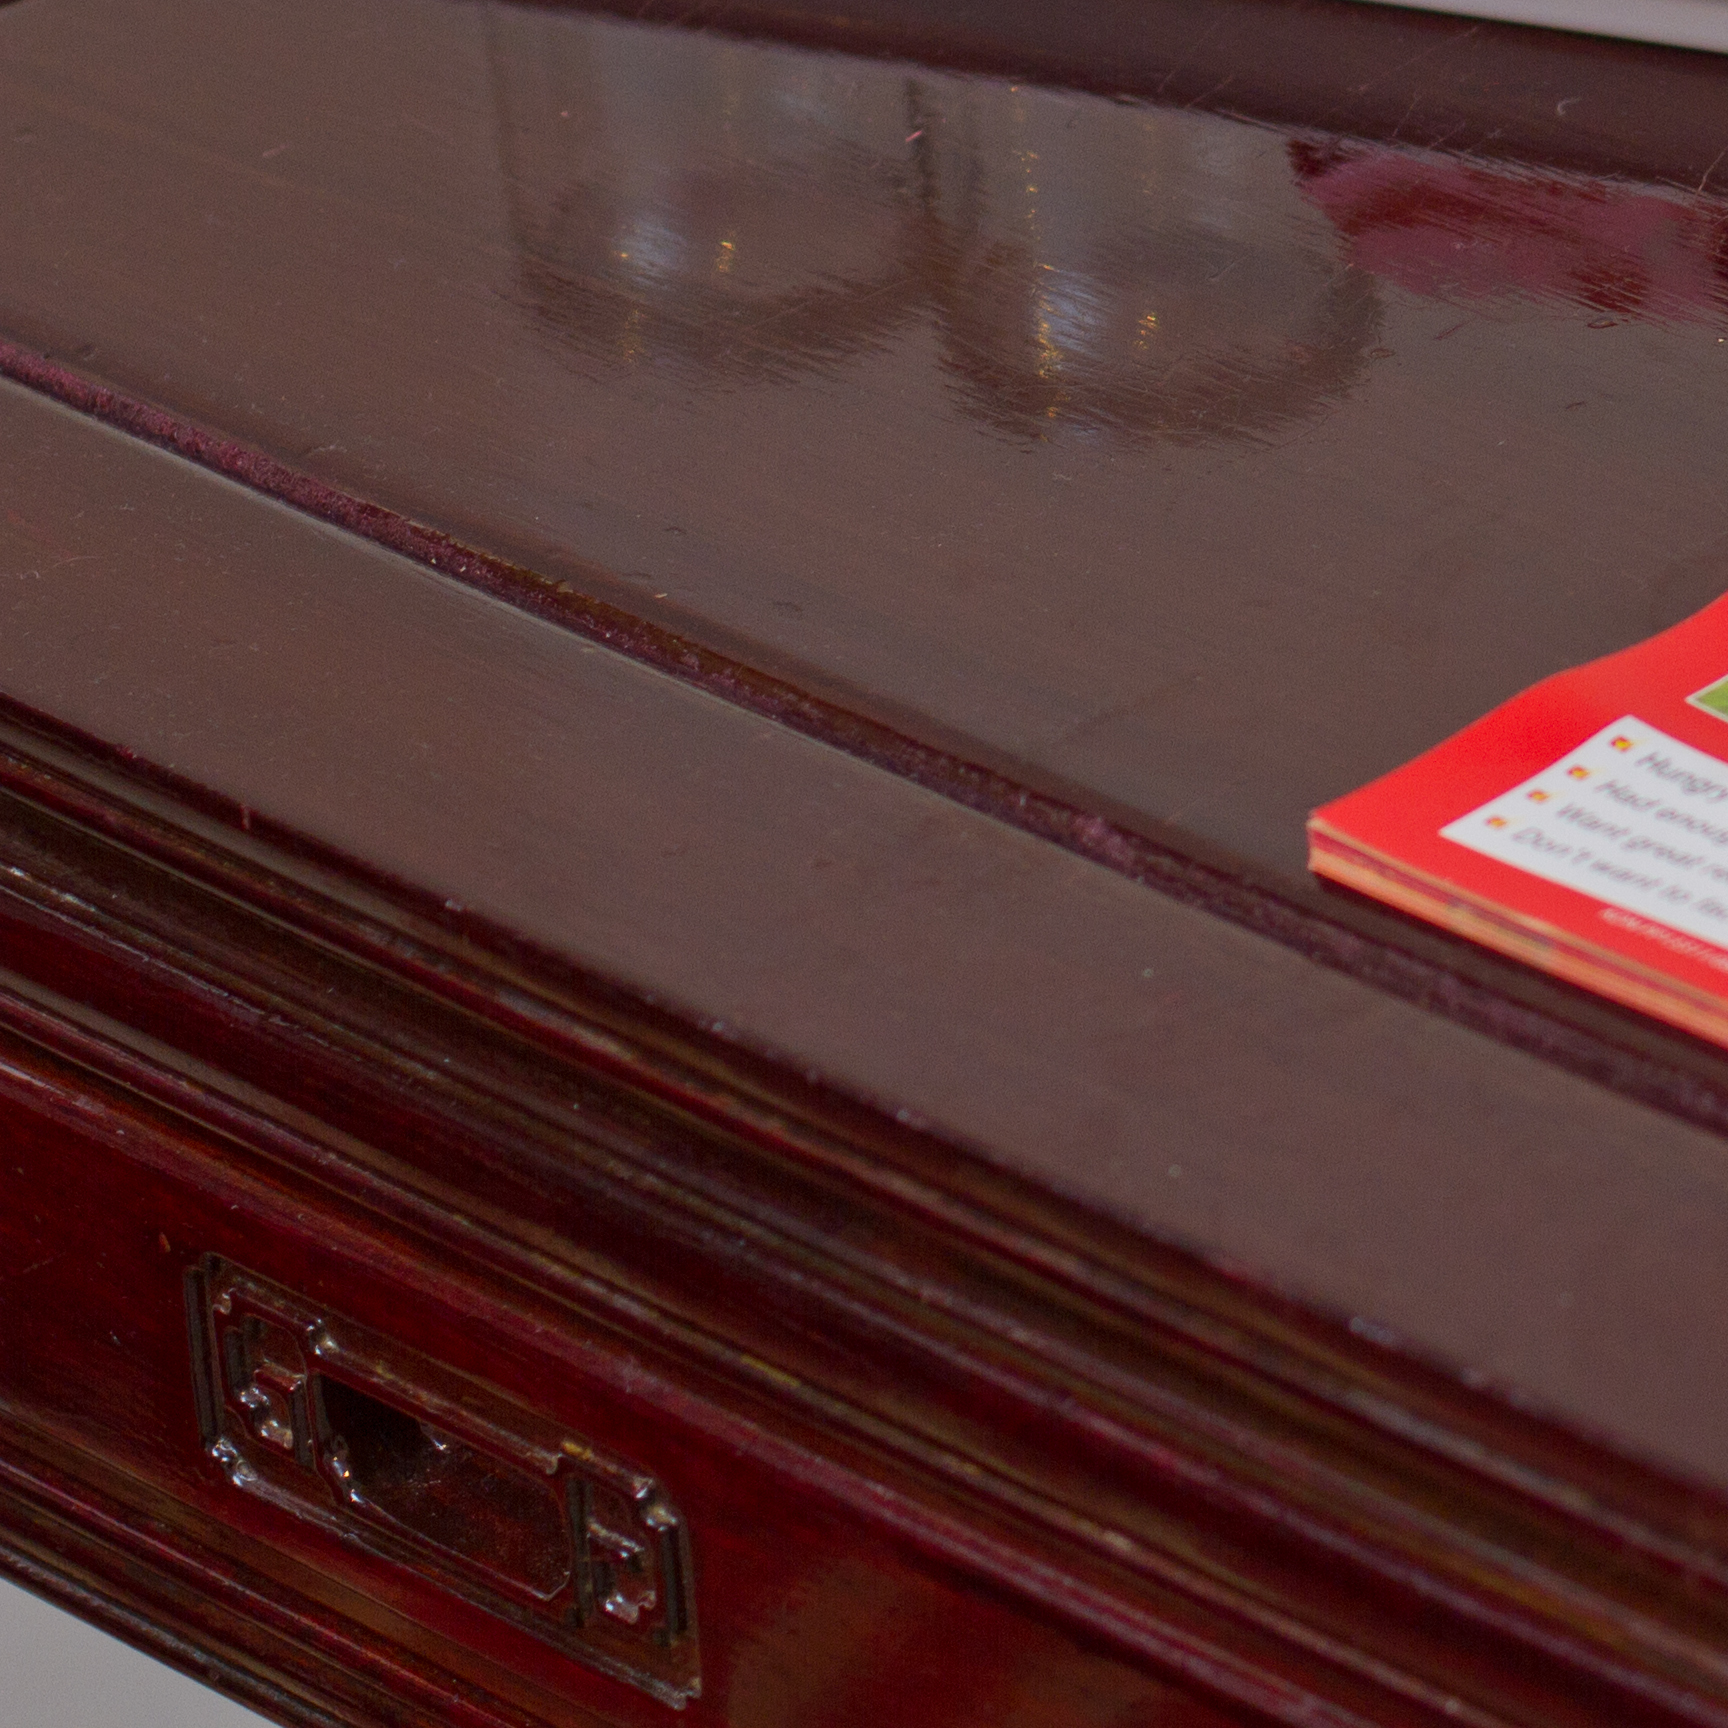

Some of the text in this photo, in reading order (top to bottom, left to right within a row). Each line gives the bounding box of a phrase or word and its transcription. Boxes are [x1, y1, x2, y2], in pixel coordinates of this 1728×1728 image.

[1593, 777, 1662, 813] Had
[1554, 802, 1632, 842] Want
[1620, 835, 1707, 871] great
[1588, 858, 1663, 892] want
